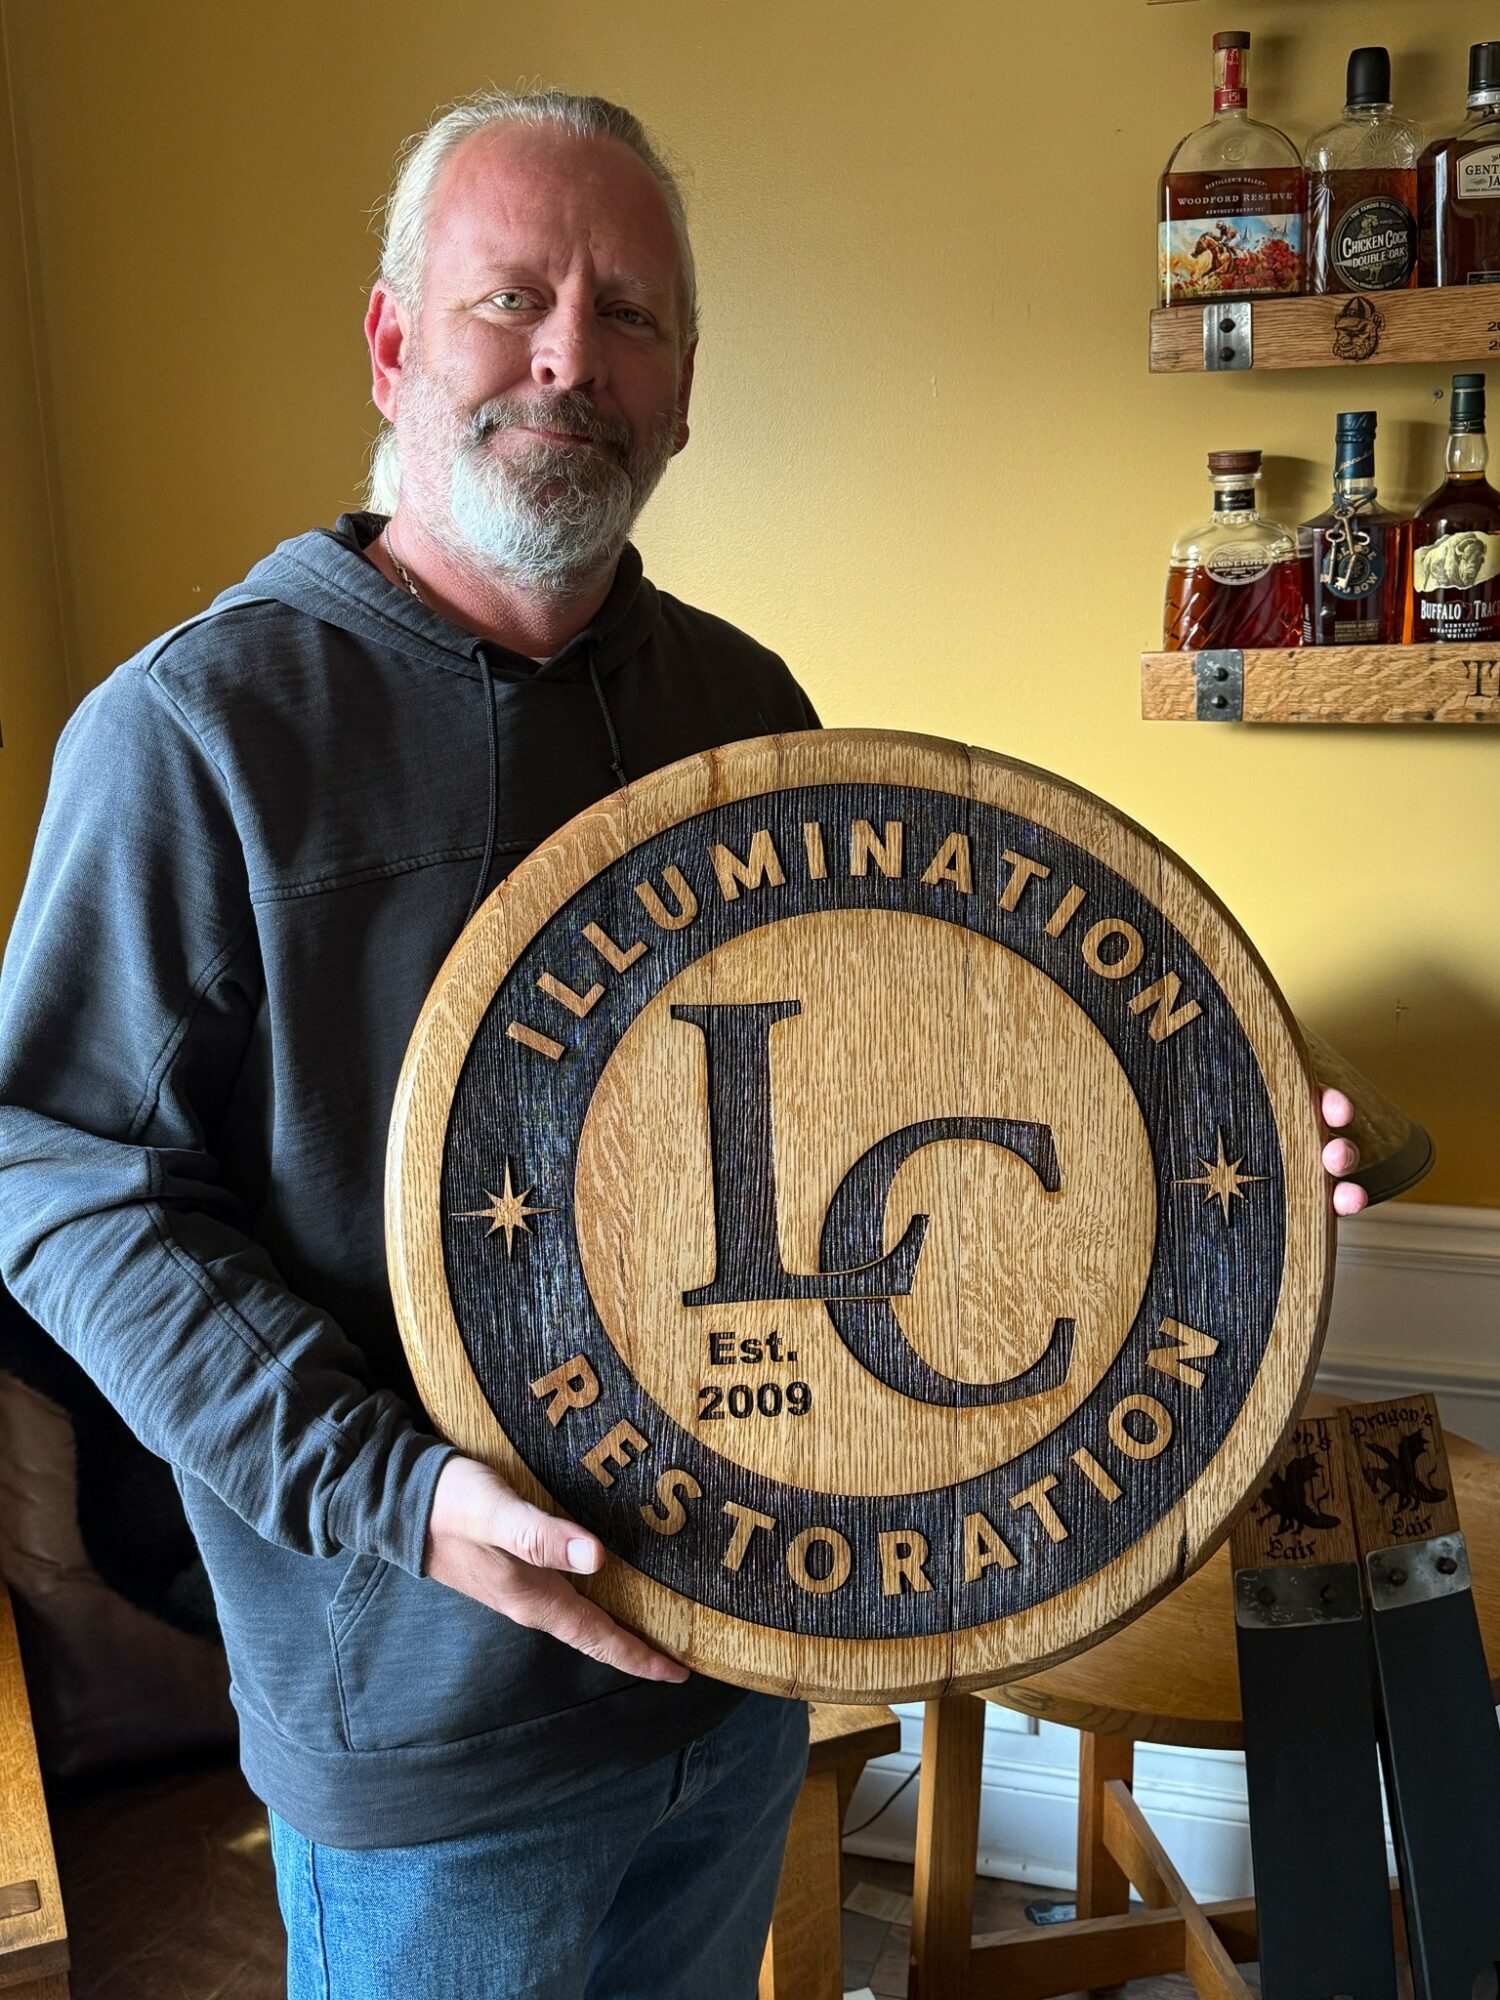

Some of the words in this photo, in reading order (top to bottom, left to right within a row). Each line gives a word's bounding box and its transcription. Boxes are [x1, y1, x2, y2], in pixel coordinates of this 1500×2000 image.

[1465, 164, 1500, 176] GENT
[1177, 195, 1240, 206] WOODFORD
[1243, 192, 1293, 202] RESERVE
[1342, 233, 1385, 258] CHICKEN
[1385, 229, 1408, 248] COCK
[1352, 249, 1388, 268] DOUBLE
[1388, 246, 1406, 259] OAK
[1353, 572, 1378, 594] BOW
[1420, 599, 1462, 620] BUFFALO
[505, 818, 1207, 1062] ILLUMINATION
[709, 1329, 798, 1366] Est.
[697, 1380, 813, 1421] 2009
[1350, 1405, 1434, 1438] Dragon's
[528, 1316, 1222, 1596] RESTORATION
[1389, 1511, 1433, 1538] Lair
[1264, 1536, 1317, 1561] Lair
